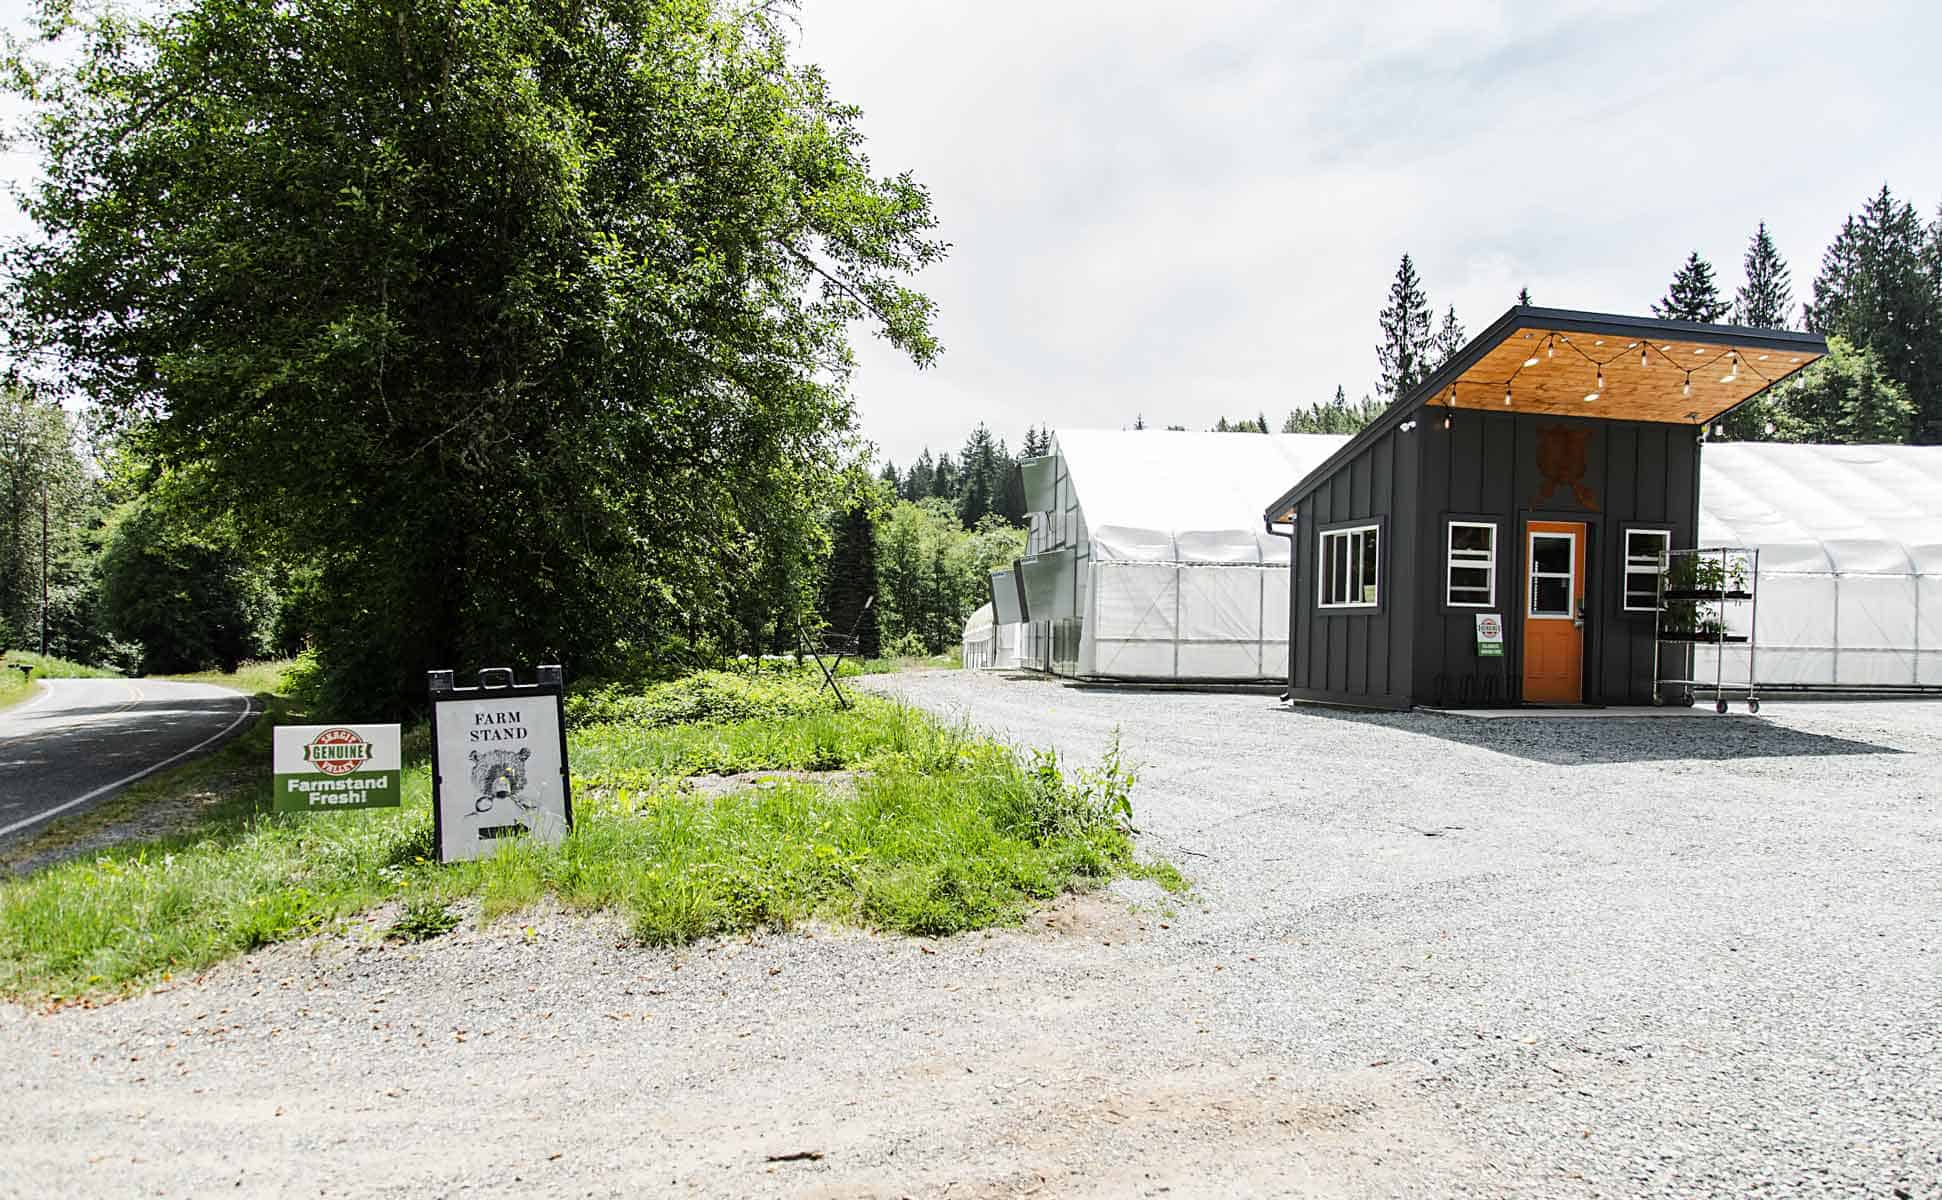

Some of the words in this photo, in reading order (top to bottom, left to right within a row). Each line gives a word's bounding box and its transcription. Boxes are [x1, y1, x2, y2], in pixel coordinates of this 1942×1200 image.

[475, 711, 521, 725] FARM
[470, 727, 528, 742] STAND
[313, 745, 364, 760] GENUINE
[287, 775, 388, 792] Farmstand
[309, 790, 367, 805] Fresh!
